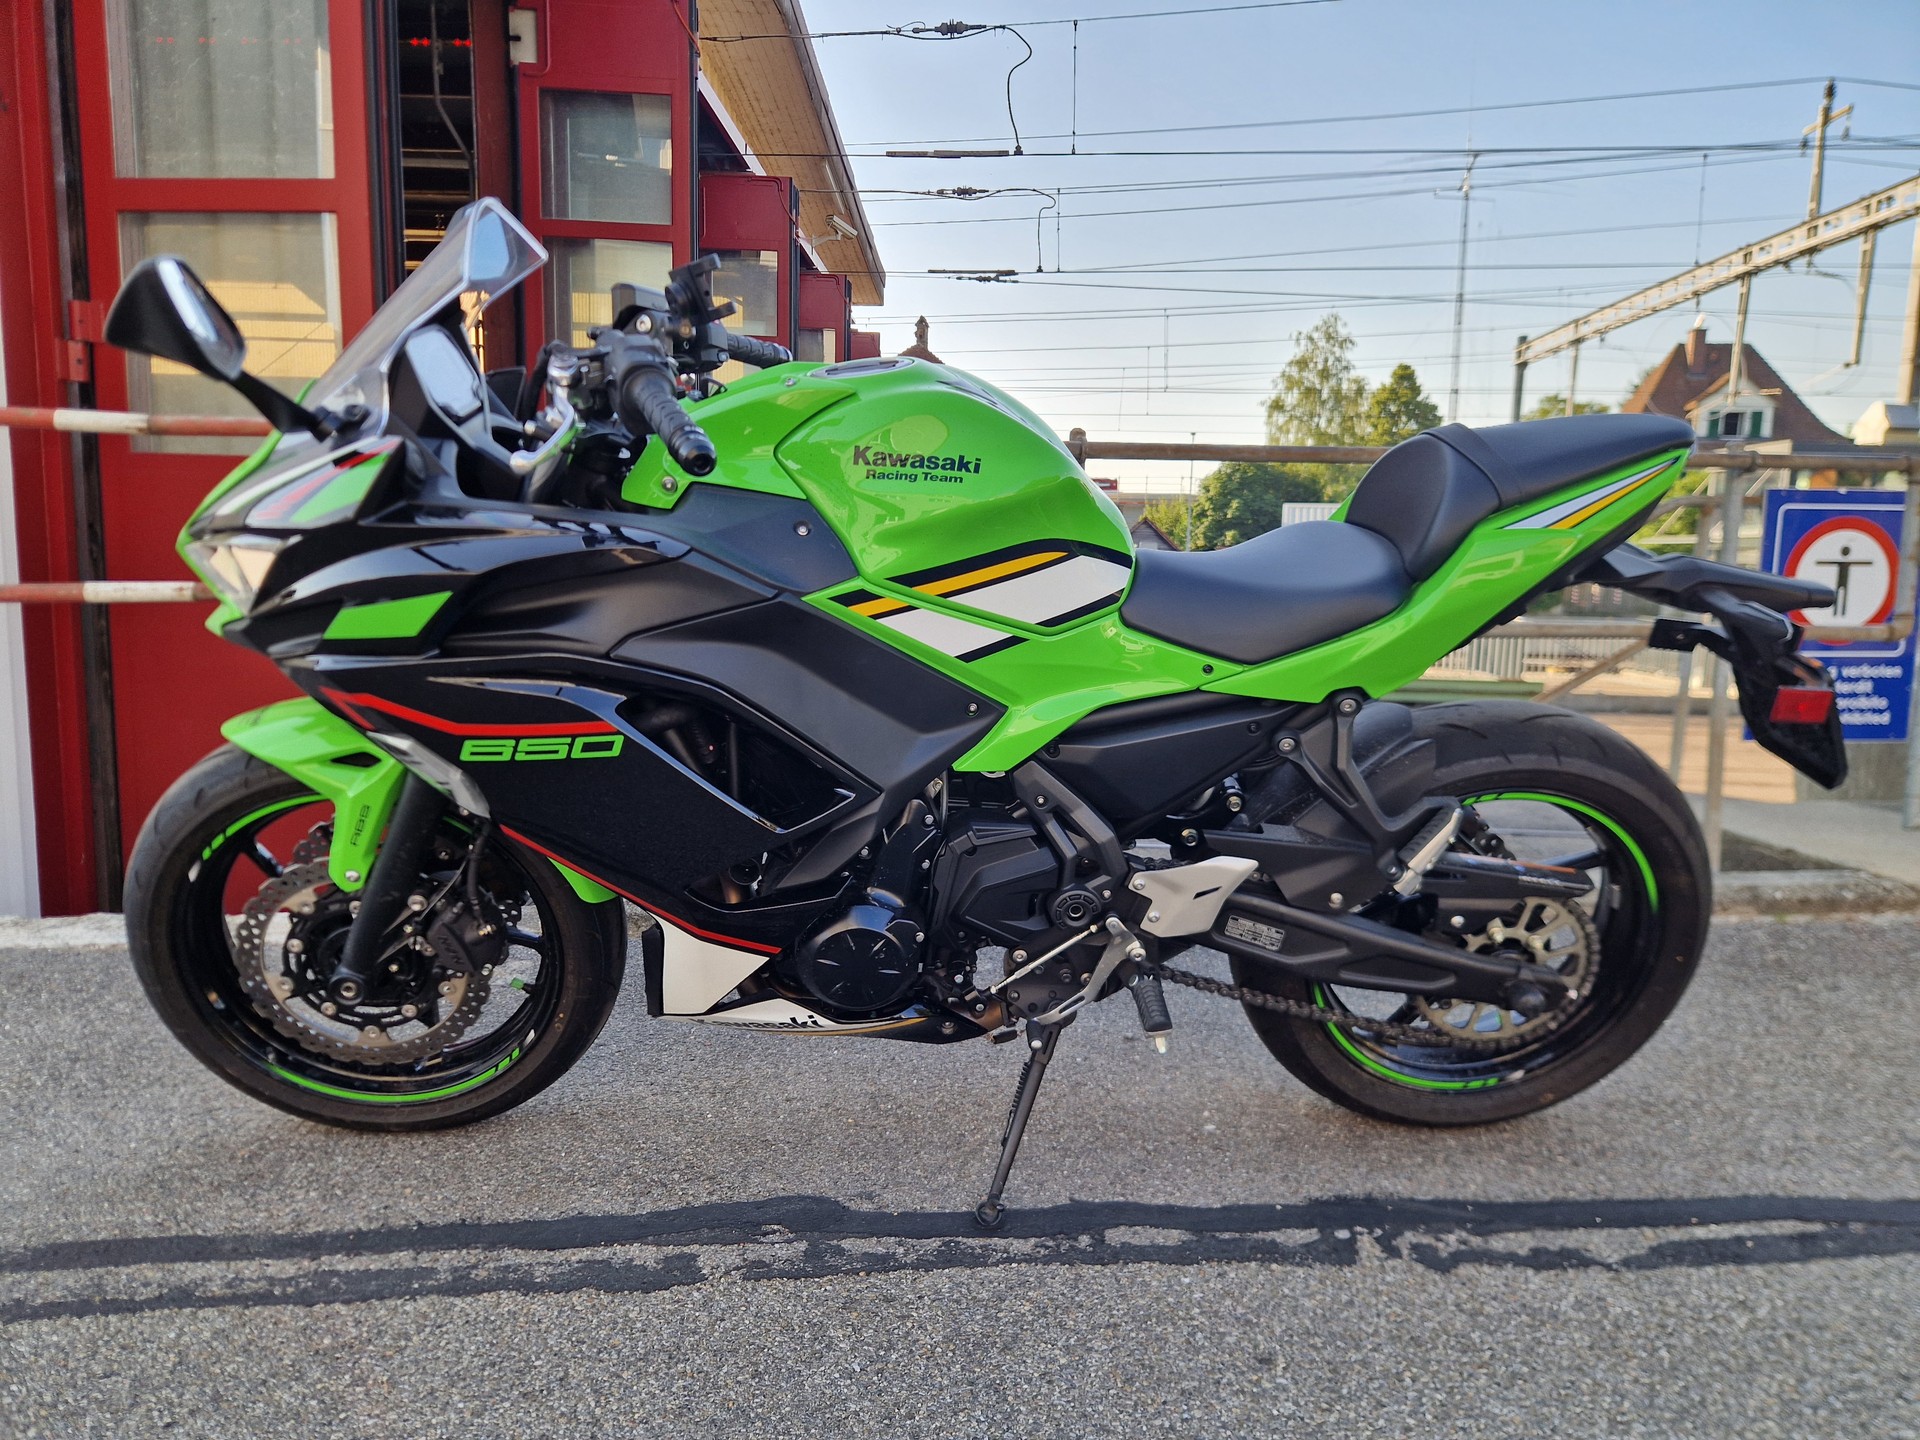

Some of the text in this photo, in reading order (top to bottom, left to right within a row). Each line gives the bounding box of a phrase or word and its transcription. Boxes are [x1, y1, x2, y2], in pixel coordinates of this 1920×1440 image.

[852, 445, 982, 475] Kawasaki
[865, 469, 964, 484] Racing Team
[459, 734, 625, 762] 650
